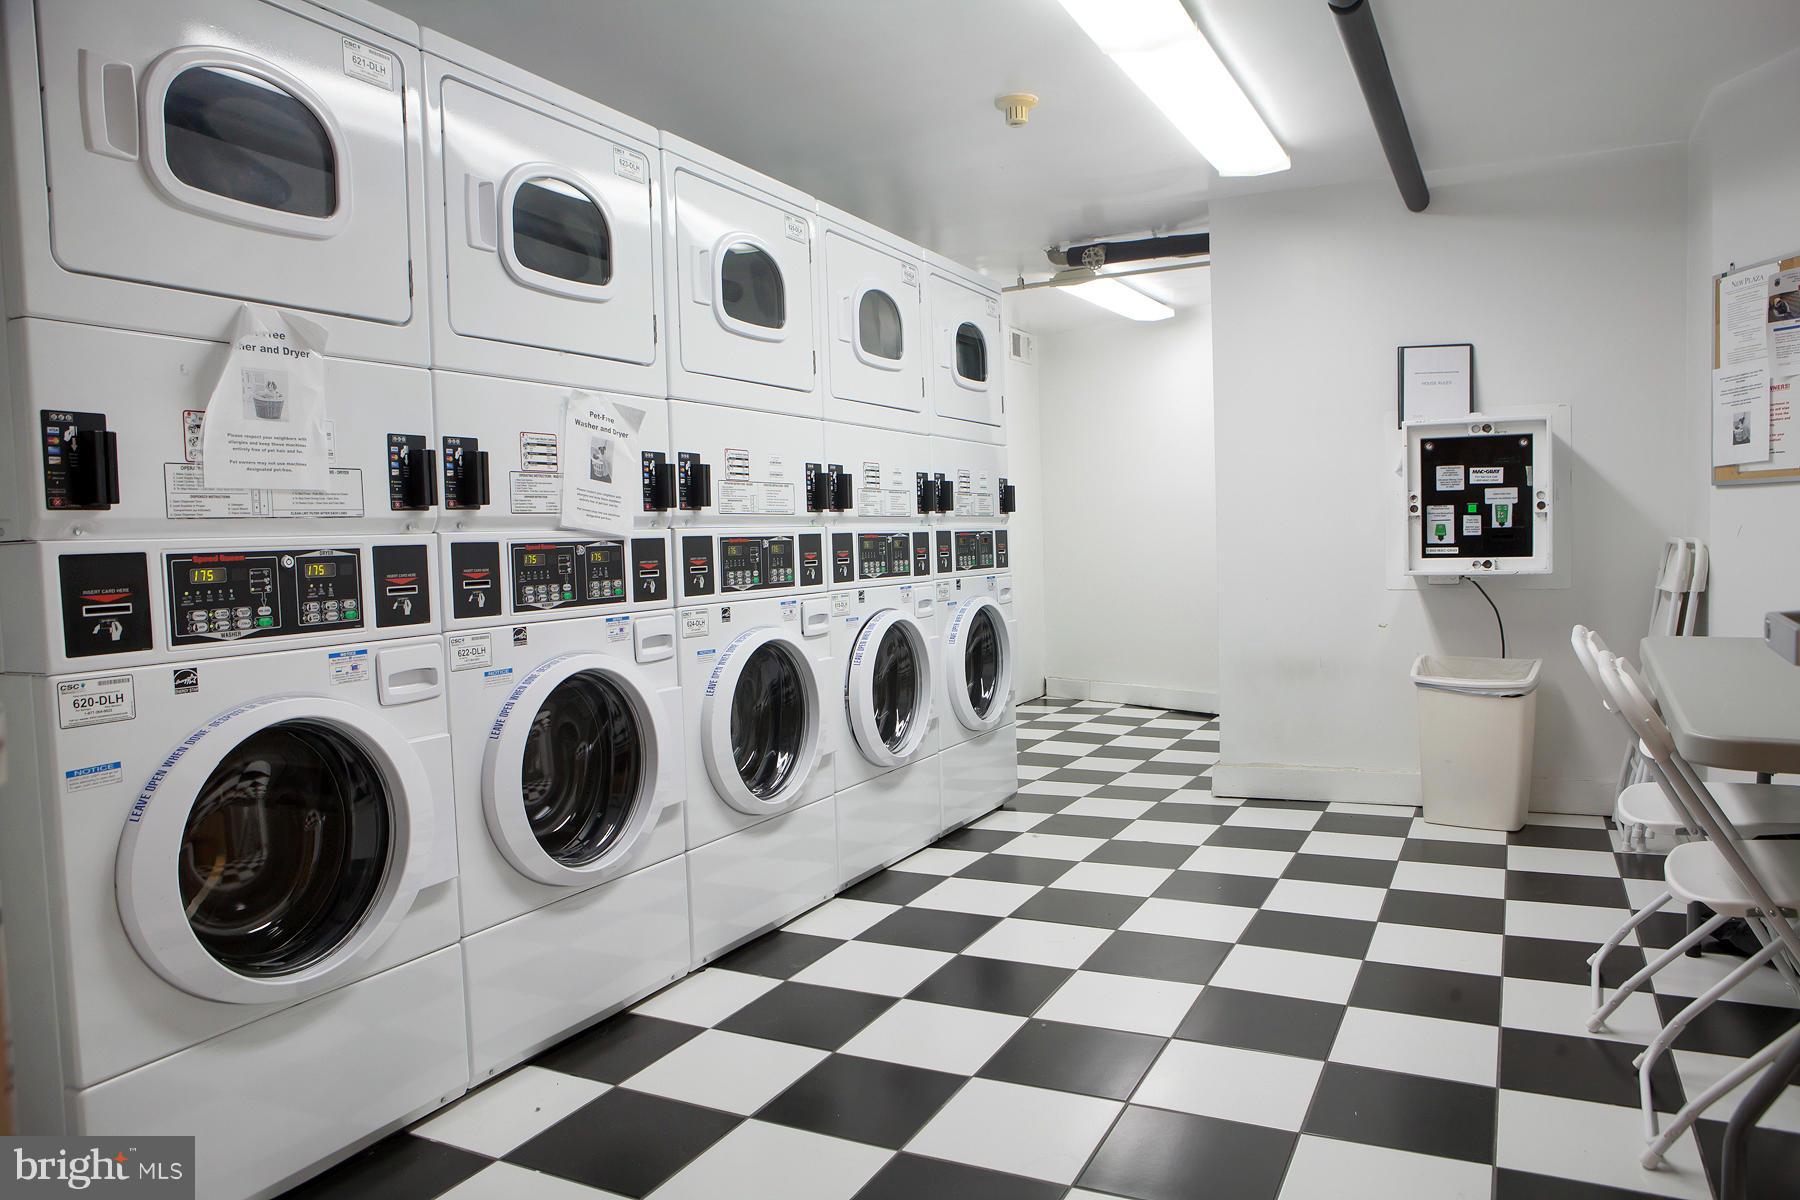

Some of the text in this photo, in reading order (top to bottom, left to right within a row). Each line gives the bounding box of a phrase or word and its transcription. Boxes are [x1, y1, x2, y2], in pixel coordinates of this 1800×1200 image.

[352, 55, 386, 75] 621-DLH
[260, 345, 280, 354] and
[282, 347, 310, 359] Dryer
[589, 410, 615, 424] Pet-Free
[575, 418, 629, 439] Washer and Dryer
[524, 555, 537, 565] 175
[591, 552, 602, 562] 175
[194, 570, 214, 582] 175
[308, 565, 325, 575] 175
[457, 646, 487, 658] 622-DLH
[711, 666, 724, 679] OPEN
[60, 683, 80, 691] CSC
[705, 680, 718, 697] LEAVE
[73, 693, 124, 709] 620-DLH
[489, 719, 506, 740] LEAVE
[499, 701, 516, 718] OPEN
[509, 686, 528, 701] WHEN
[74, 764, 113, 776] NOTICE
[129, 794, 152, 823] LEAVE
[145, 769, 168, 792] OPEN
[161, 746, 189, 768] WHEN
